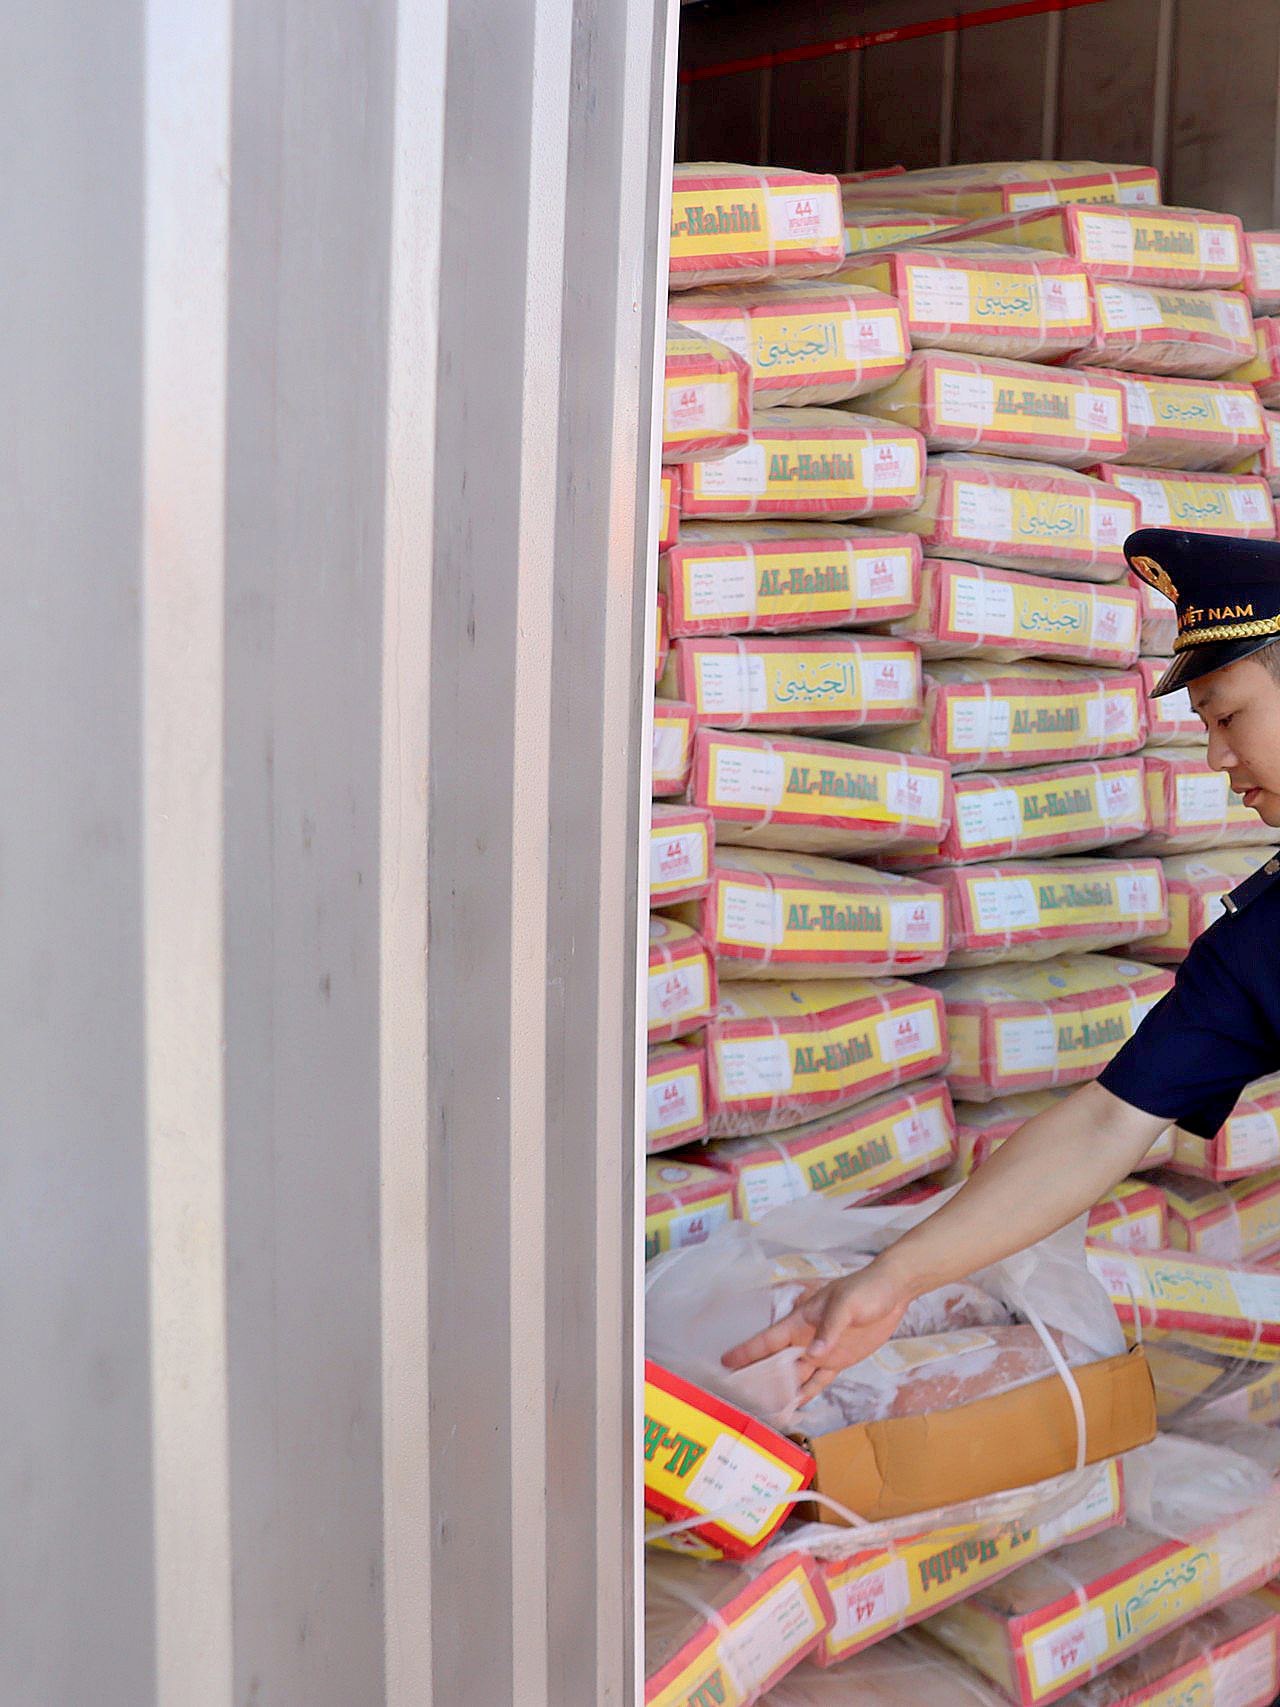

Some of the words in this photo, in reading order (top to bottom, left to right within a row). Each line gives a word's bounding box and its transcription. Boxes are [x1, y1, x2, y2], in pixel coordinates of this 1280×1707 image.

[795, 201, 812, 216] 44
[859, 325, 874, 338] 44
[680, 391, 698, 407] 44
[879, 448, 893, 460] 44
[768, 453, 855, 482] AL-Habibi
[873, 559, 888, 575] 44
[758, 565, 849, 597] AL-Habibi
[1208, 603, 1254, 621] NAM
[881, 666, 895, 680] 44
[786, 766, 878, 801] AL-Habibi
[666, 842, 681, 857] 44
[786, 903, 883, 932] AL-Habibi
[912, 907, 926, 921] 44
[665, 976, 681, 993] 44
[898, 1022, 912, 1035] 44
[664, 1085, 678, 1100] 44
[688, 1217, 703, 1234] 44
[856, 1601, 875, 1624] 44
[1061, 1649, 1079, 1671] 44
